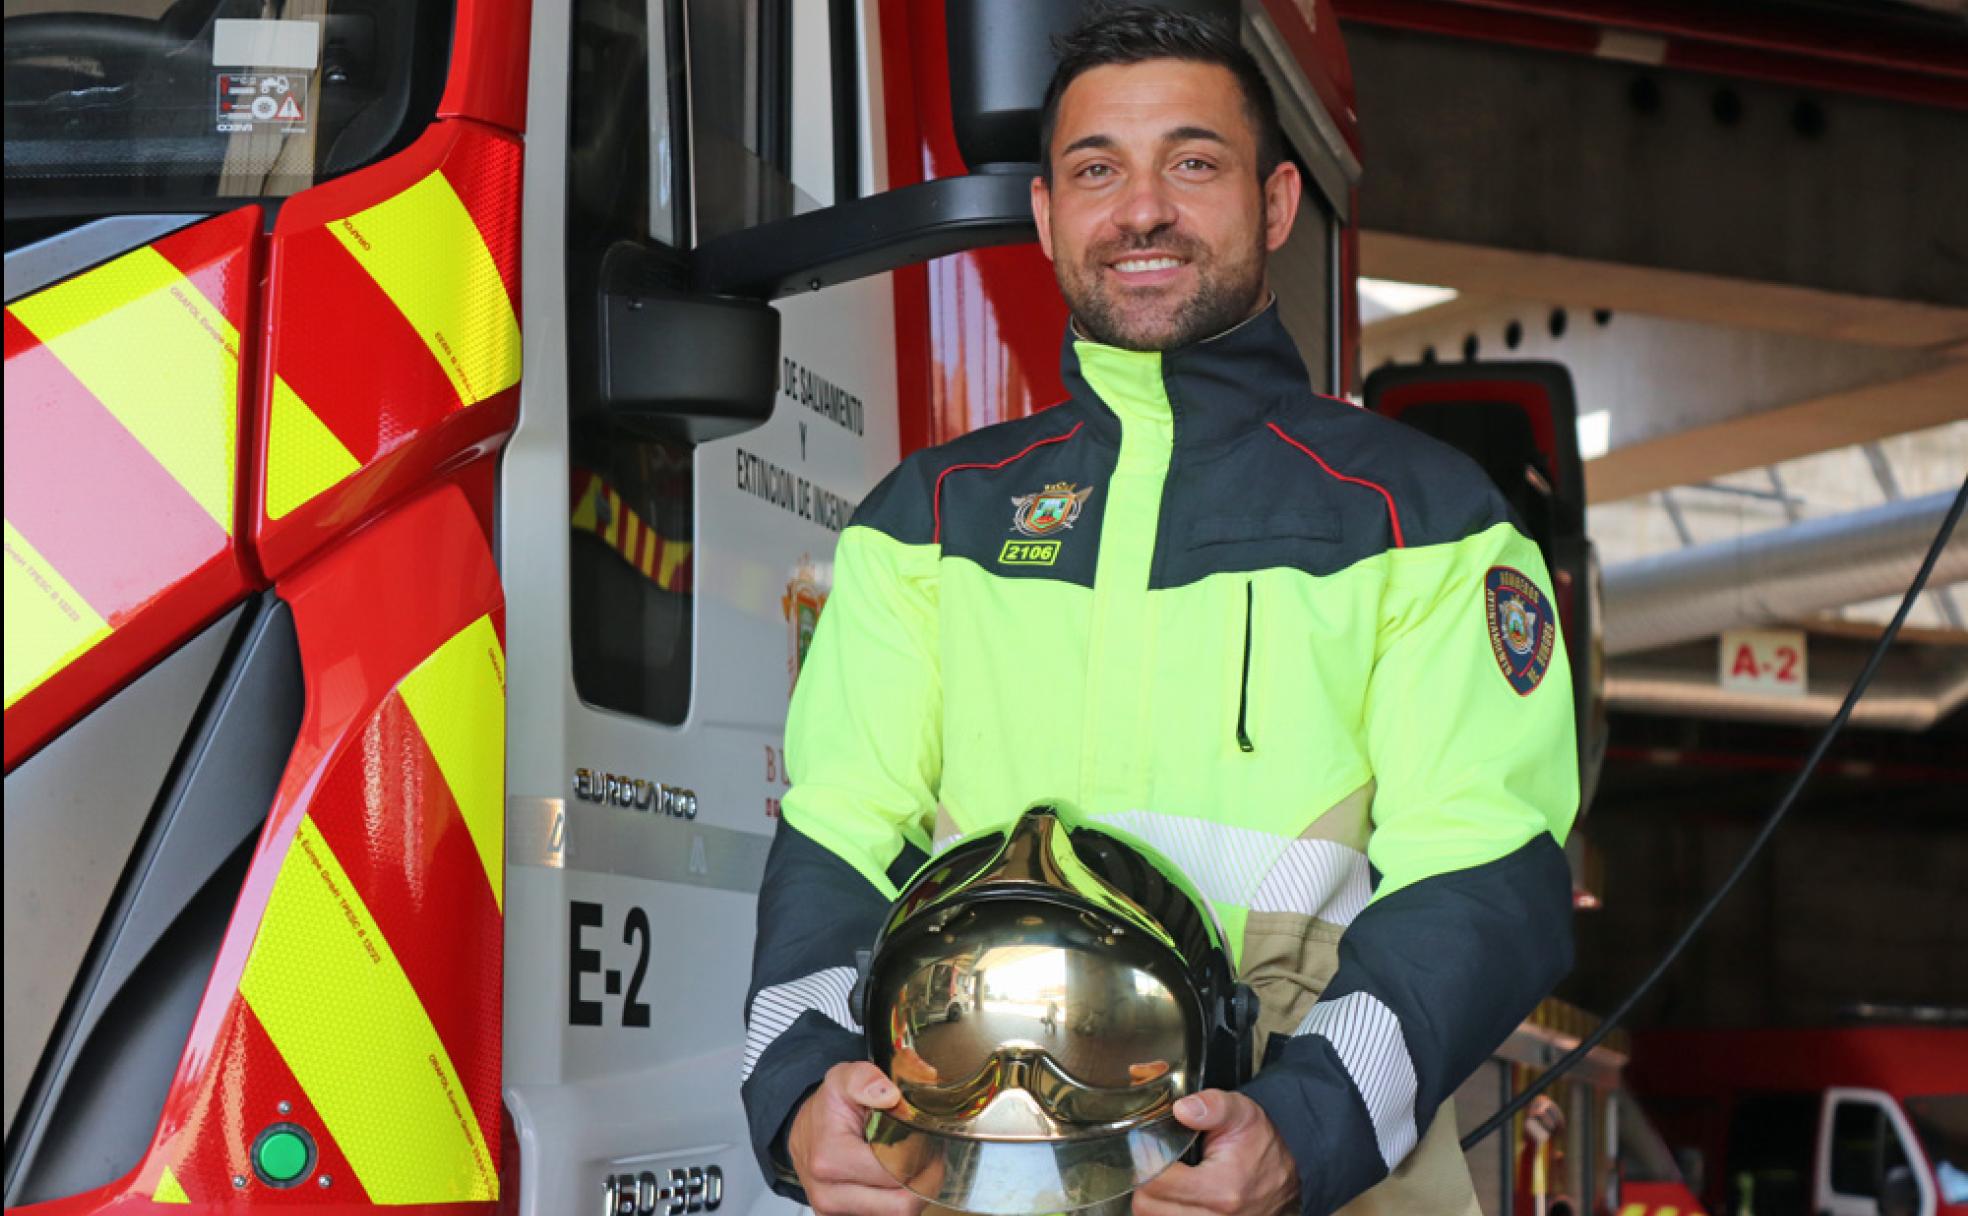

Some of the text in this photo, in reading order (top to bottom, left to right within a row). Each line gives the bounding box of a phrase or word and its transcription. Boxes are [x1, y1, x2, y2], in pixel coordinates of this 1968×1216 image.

[784, 356, 864, 437] DE SALVAMENTO
[799, 421, 807, 462] Y
[737, 448, 796, 513] EXTINCION
[799, 477, 812, 521] DE
[1006, 544, 1054, 561] 2106
[1731, 643, 1799, 682] A-2
[572, 767, 698, 820] EUROCARGO
[569, 900, 650, 1027] E-2
[602, 1164, 723, 1216] 160-320
